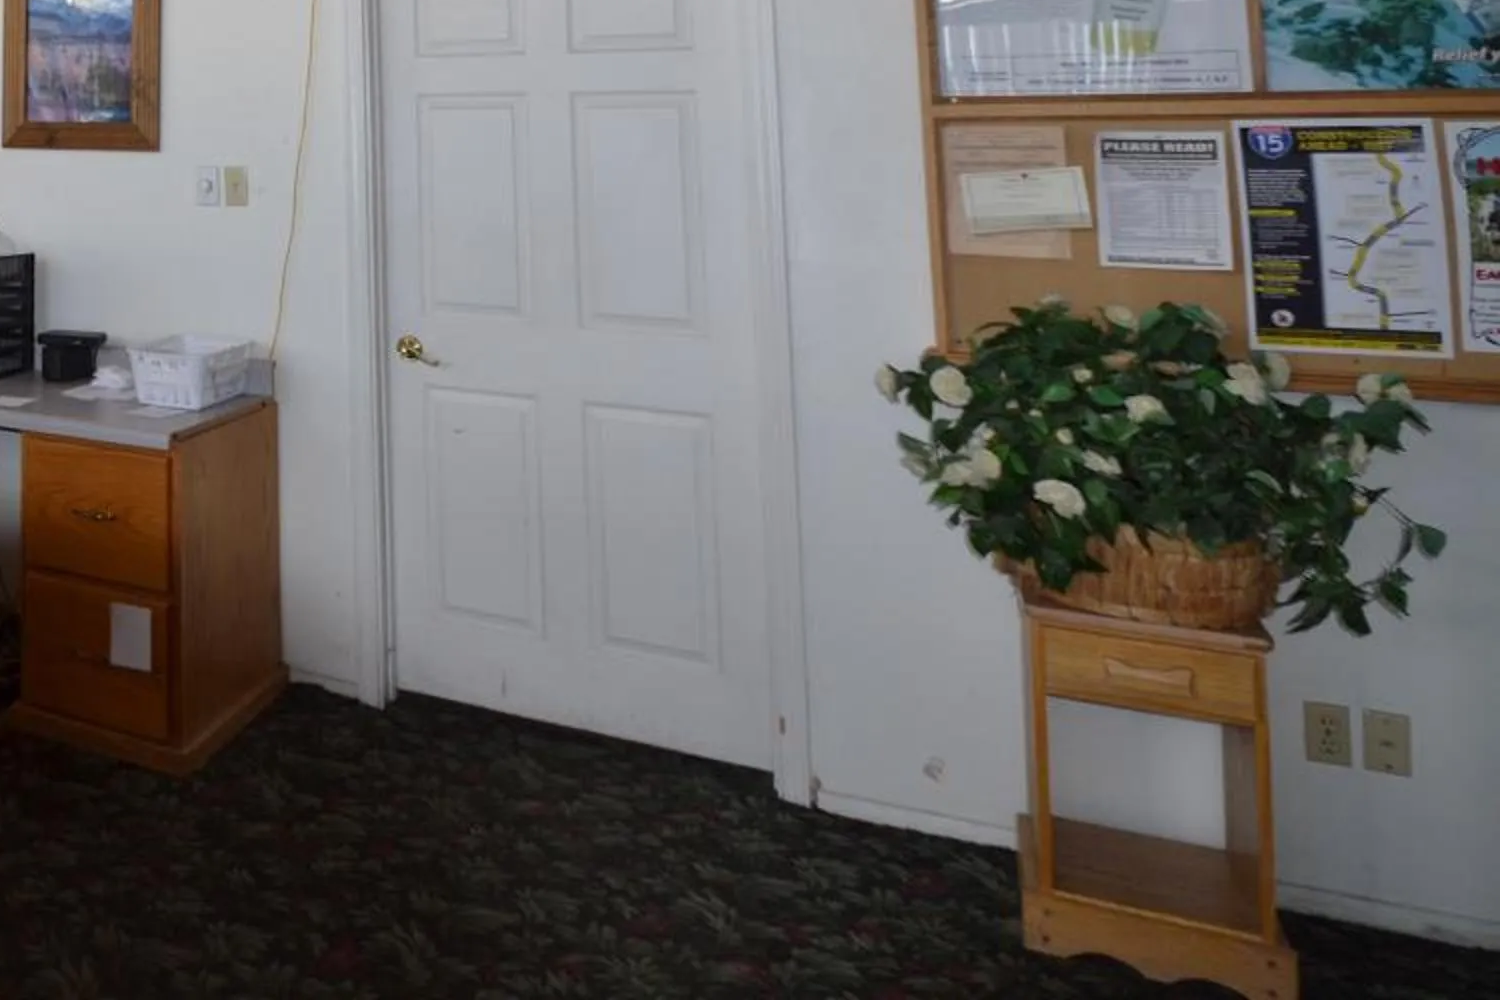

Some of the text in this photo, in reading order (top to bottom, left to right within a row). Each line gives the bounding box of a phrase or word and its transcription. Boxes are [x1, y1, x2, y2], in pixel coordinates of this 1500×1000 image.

[1432, 45, 1488, 63] Relief
[1103, 140, 1161, 153] PLEASE
[1255, 134, 1284, 153] 15
